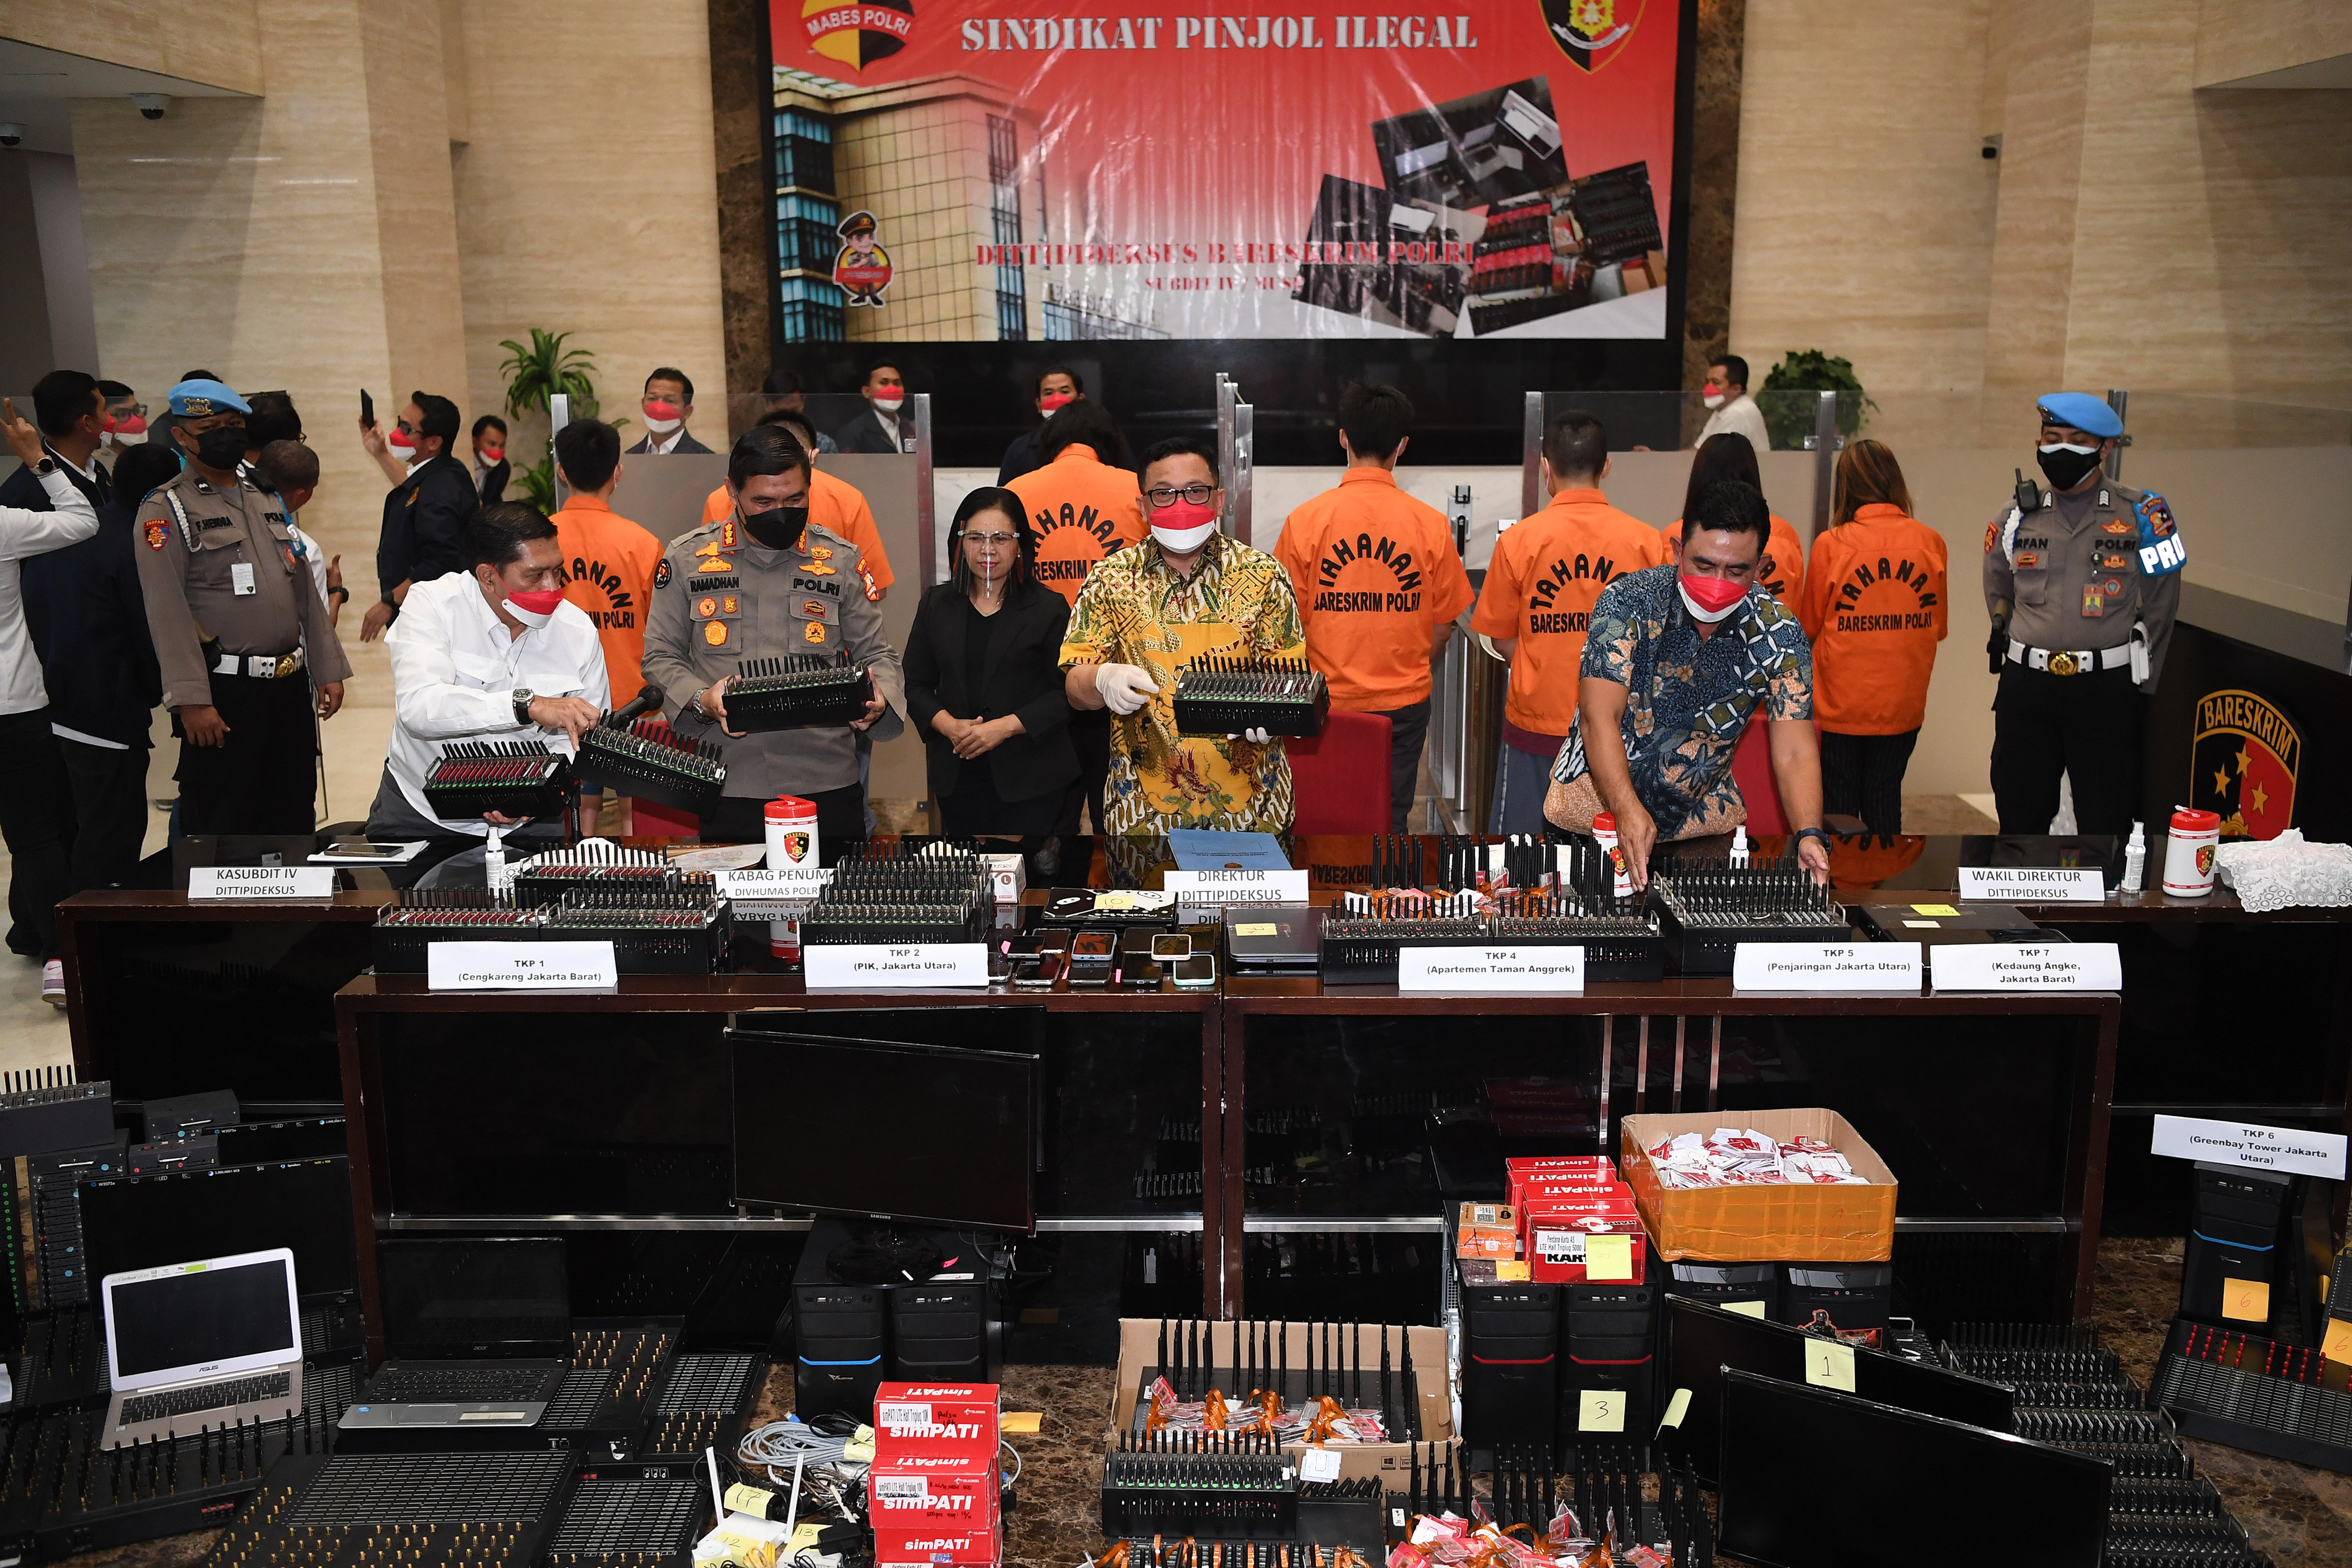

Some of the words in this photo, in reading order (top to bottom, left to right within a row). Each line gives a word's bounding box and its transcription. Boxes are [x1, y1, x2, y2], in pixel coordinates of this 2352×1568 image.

[806, 9, 860, 36] MABES
[864, 9, 911, 35] POLRI
[961, 17, 1163, 51] SINDIKAT
[1175, 16, 1323, 49] PINJOL
[1335, 15, 1478, 49] ILEGAL
[1208, 242, 1378, 265] BARESKRIM
[1388, 241, 1474, 264] POLRI
[2094, 539, 2137, 551] POLRI
[690, 577, 740, 592] RAMADHAN
[794, 578, 840, 596] POLRI
[1835, 557, 1937, 611] TAHANAN
[1387, 592, 1421, 612] POLRI
[603, 611, 634, 630] POLRI
[1838, 614, 1902, 632] BARESKRIM
[2204, 696, 2293, 761] BARESKRIM
[216, 868, 282, 880] KASUBDIT
[285, 868, 298, 879] IV
[729, 871, 774, 881] KABAG
[779, 870, 828, 881] PENUM
[1198, 870, 1265, 882] DIREKTUR
[1972, 870, 2014, 881] WAKIL
[2018, 871, 2082, 882] DIREKTUR
[216, 885, 295, 895] DITTIPIDEKSUS
[736, 887, 790, 896] DIVHUMAS
[1182, 890, 1282, 901] DITTIPIDEKSUS
[1988, 888, 2069, 898] DITTIPIDEKSUS
[854, 962, 878, 972] (PIK,
[924, 962, 956, 971] Utara)
[1427, 966, 1486, 975] (Apartemen
[1528, 965, 1575, 974] Anggrek)
[1768, 963, 1832, 972] (Penjaringan
[1878, 962, 1910, 972] Utara)
[1992, 962, 2041, 972] (Kedaung
[2044, 962, 2081, 971] Angke,
[458, 973, 524, 982] (Cengkareng
[570, 972, 602, 981] Barat)
[2043, 975, 2075, 984] Barat)
[2242, 1129, 2264, 1138] TKP
[2189, 1135, 2244, 1149] (Greenbay
[2247, 1142, 2282, 1153] Tower
[2284, 1146, 2328, 1158] Jakarta
[2240, 1154, 2274, 1165] Utara)
[1547, 1235, 1561, 1243] Perdana
[1561, 1235, 1570, 1243] Kartu
[1558, 1243, 1571, 1252] Triplug
[2240, 1292, 2251, 1308] 6
[2335, 1336, 2348, 1351] 6
[1822, 1356, 1834, 1376] 1
[906, 1388, 973, 1396] simPATI
[1595, 1401, 1608, 1420] 3
[890, 1423, 980, 1439] simPATI
[897, 1458, 970, 1466] simPATI
[736, 1487, 761, 1507] 17
[883, 1495, 972, 1510] simPATI
[799, 1527, 814, 1536] 13
[905, 1539, 970, 1550] simPATI
